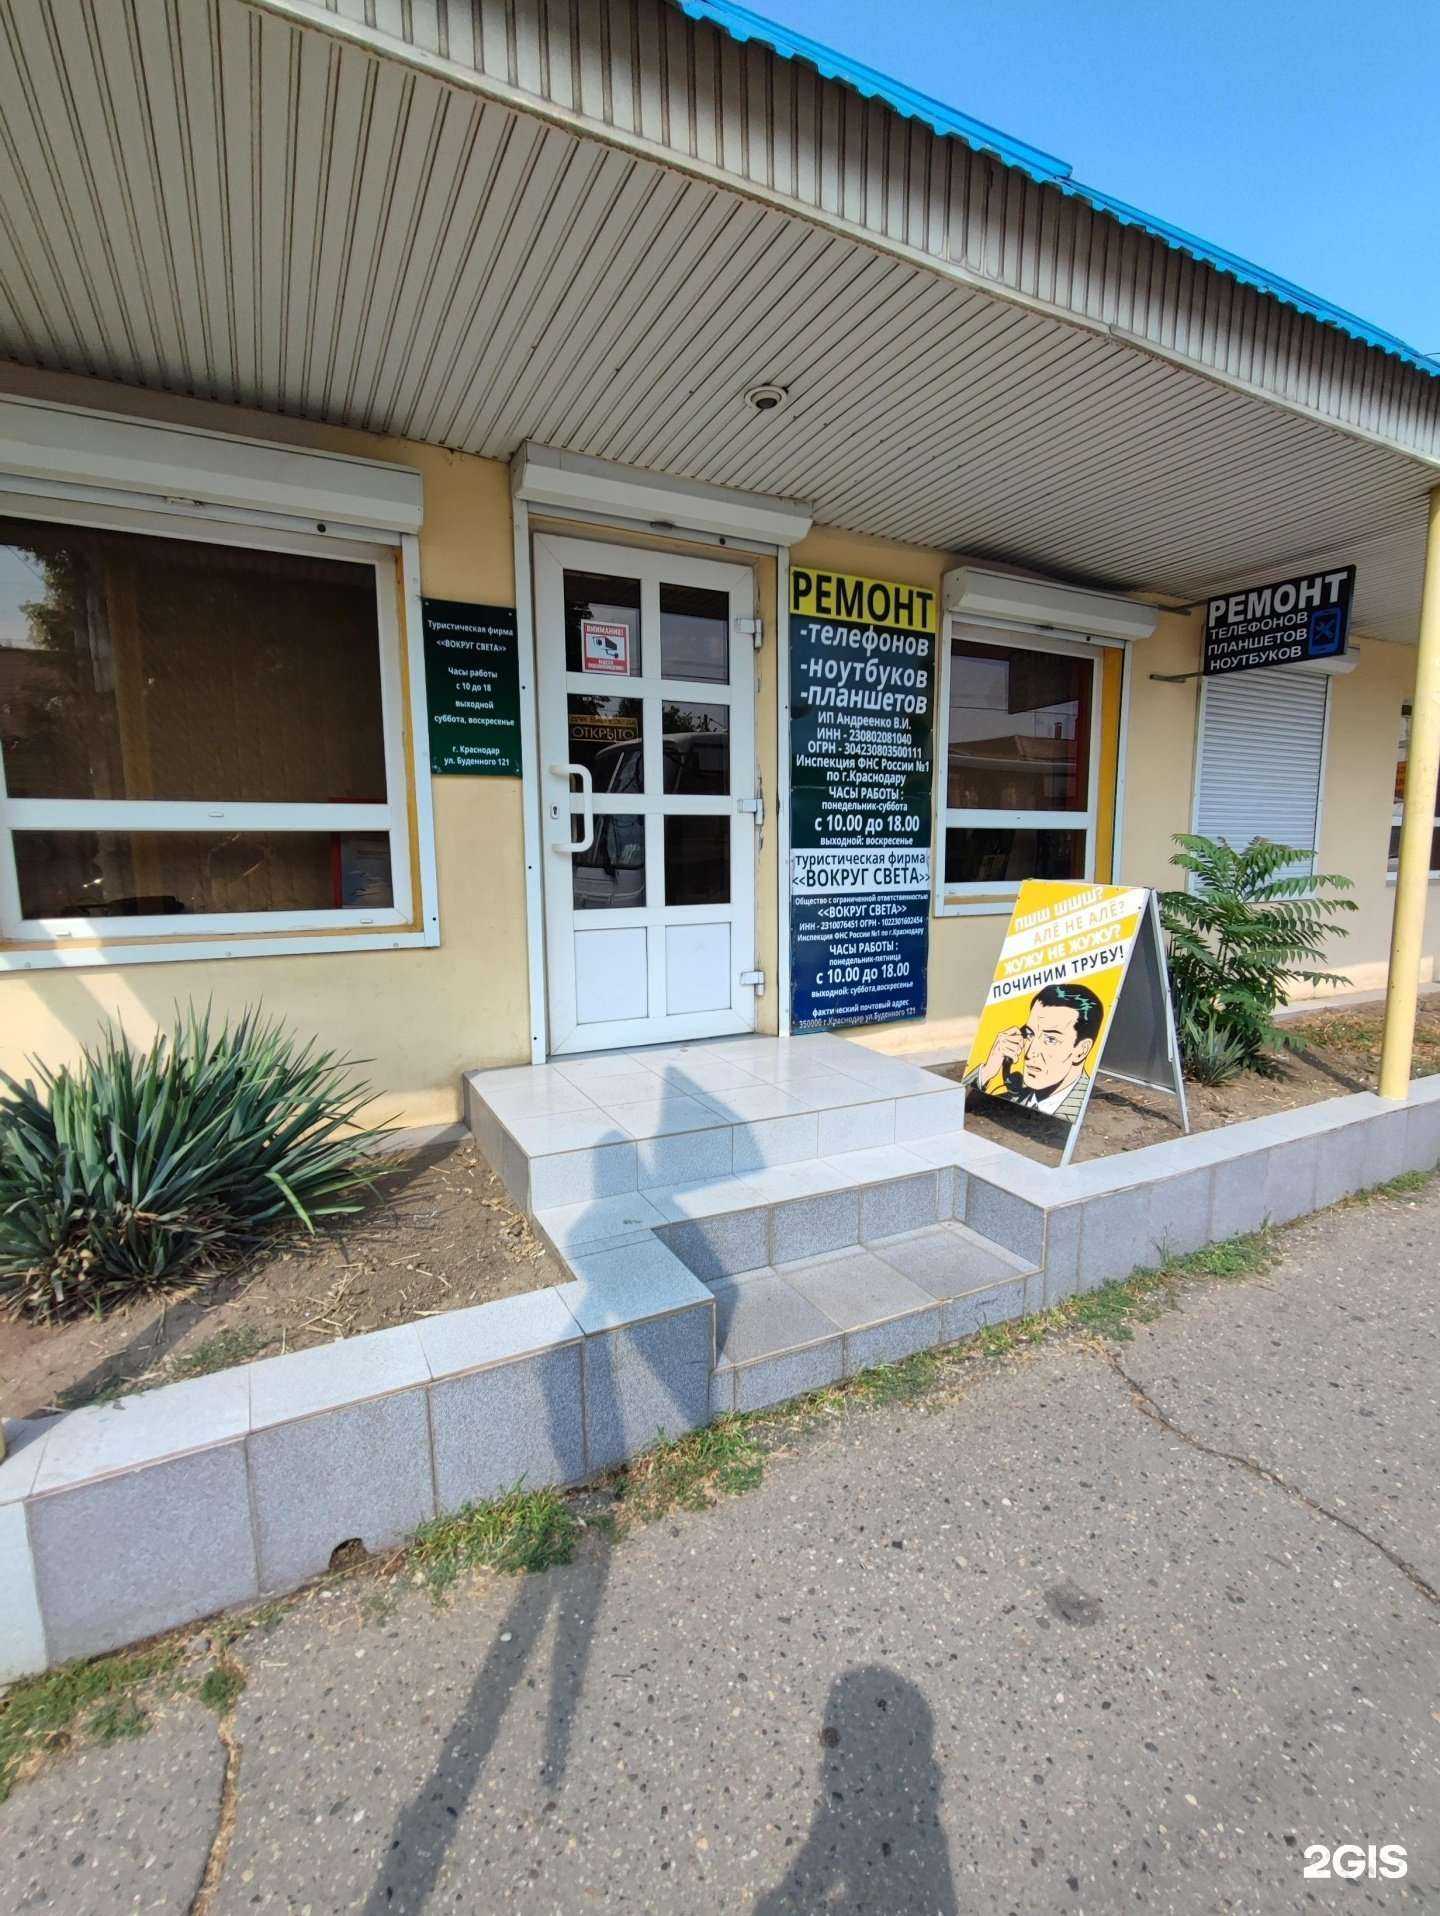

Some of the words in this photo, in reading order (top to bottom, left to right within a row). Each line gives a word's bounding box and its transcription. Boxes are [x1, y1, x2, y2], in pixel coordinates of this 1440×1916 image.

[792, 569, 933, 629] РЕМОНТ
[1208, 571, 1348, 628] РЕМОНТ
[428, 619, 486, 633] Туристическая
[487, 626, 514, 637] фирма
[1210, 611, 1308, 640] ТЕЛЕФОНОВ
[1208, 628, 1308, 656] ПЛАНШЕТОВ
[1210, 645, 1302, 671] НОУТБУКОВ
[448, 667, 469, 677] Часы
[469, 669, 498, 679] работы
[462, 682, 471, 691] 10
[472, 684, 482, 693] до
[484, 684, 492, 692] 18
[455, 701, 494, 710] выходной
[817, 711, 834, 723] ИП
[837, 712, 892, 729] Андреенко
[893, 717, 912, 730] В.И.
[572, 726, 635, 740] ОТКРЫТО
[817, 727, 841, 740] ИНН
[460, 745, 500, 756] Краснодар
[808, 740, 836, 754] ОГРН
[457, 756, 497, 767] Буденного
[498, 758, 510, 767] 121
[796, 754, 855, 771] Инспекция
[857, 758, 880, 770] ФНС
[881, 759, 914, 771] России
[826, 771, 840, 781] по
[842, 770, 907, 787] г.Краснодару
[828, 785, 859, 799] ЧАСЫ
[821, 801, 908, 813] понедельник-суббота
[826, 814, 863, 832] 10.00
[864, 818, 884, 835] до
[887, 815, 920, 832] 18.00
[820, 835, 864, 847] выходной:
[865, 836, 914, 847] воскресенье
[795, 854, 885, 870] туристическая
[888, 850, 927, 868] фирма
[795, 897, 828, 906] Общество
[799, 922, 816, 931] ИНН
[860, 919, 877, 928] ОГРН
[1034, 925, 1060, 945] АЛЕ
[1065, 915, 1083, 936] НЕ
[834, 932, 848, 940] ФНС
[829, 943, 857, 956] ЧАСЫ
[1047, 943, 1066, 960] НЕ
[827, 966, 860, 983] 10.00
[861, 967, 878, 984] до
[881, 962, 910, 979] 18.00
[993, 964, 1067, 999] ПОЧИНИМ
[1072, 945, 1124, 973] ТРУБУ!
